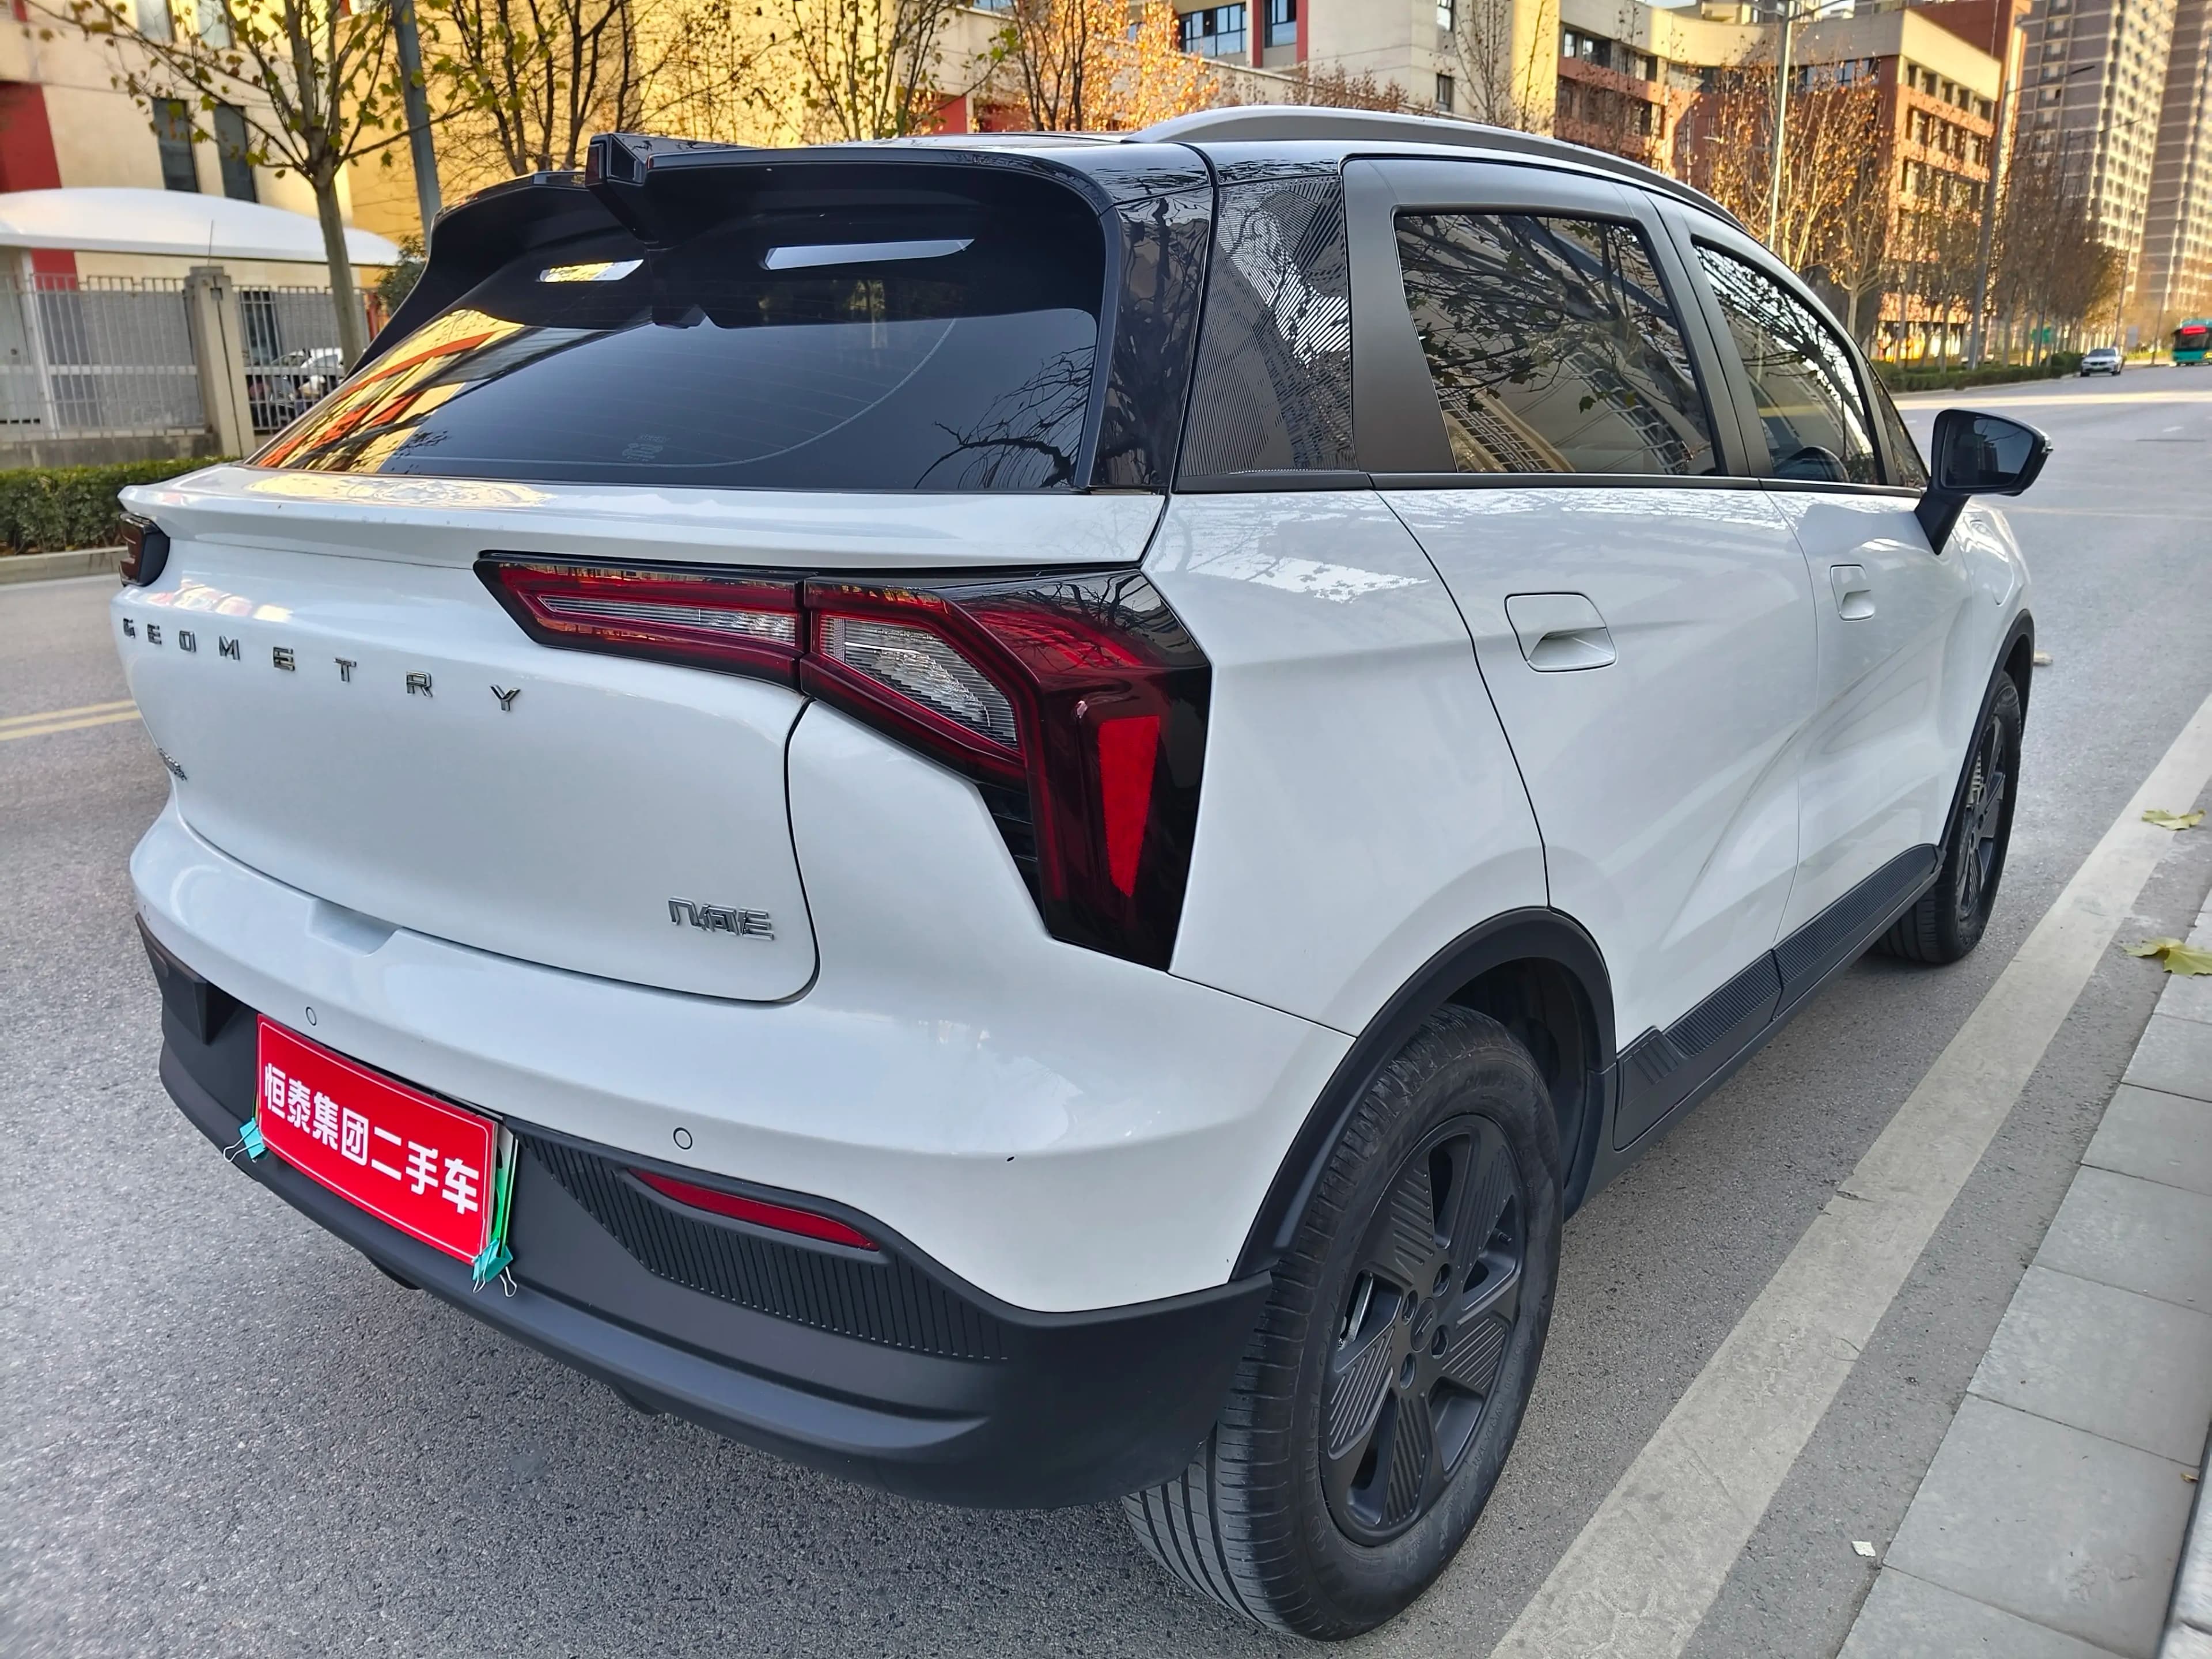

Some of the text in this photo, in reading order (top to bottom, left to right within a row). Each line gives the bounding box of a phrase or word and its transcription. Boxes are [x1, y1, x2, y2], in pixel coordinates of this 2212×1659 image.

[123, 618, 521, 711] GEOMETRY
[264, 1063, 480, 1215] 恒泰集团二手车
